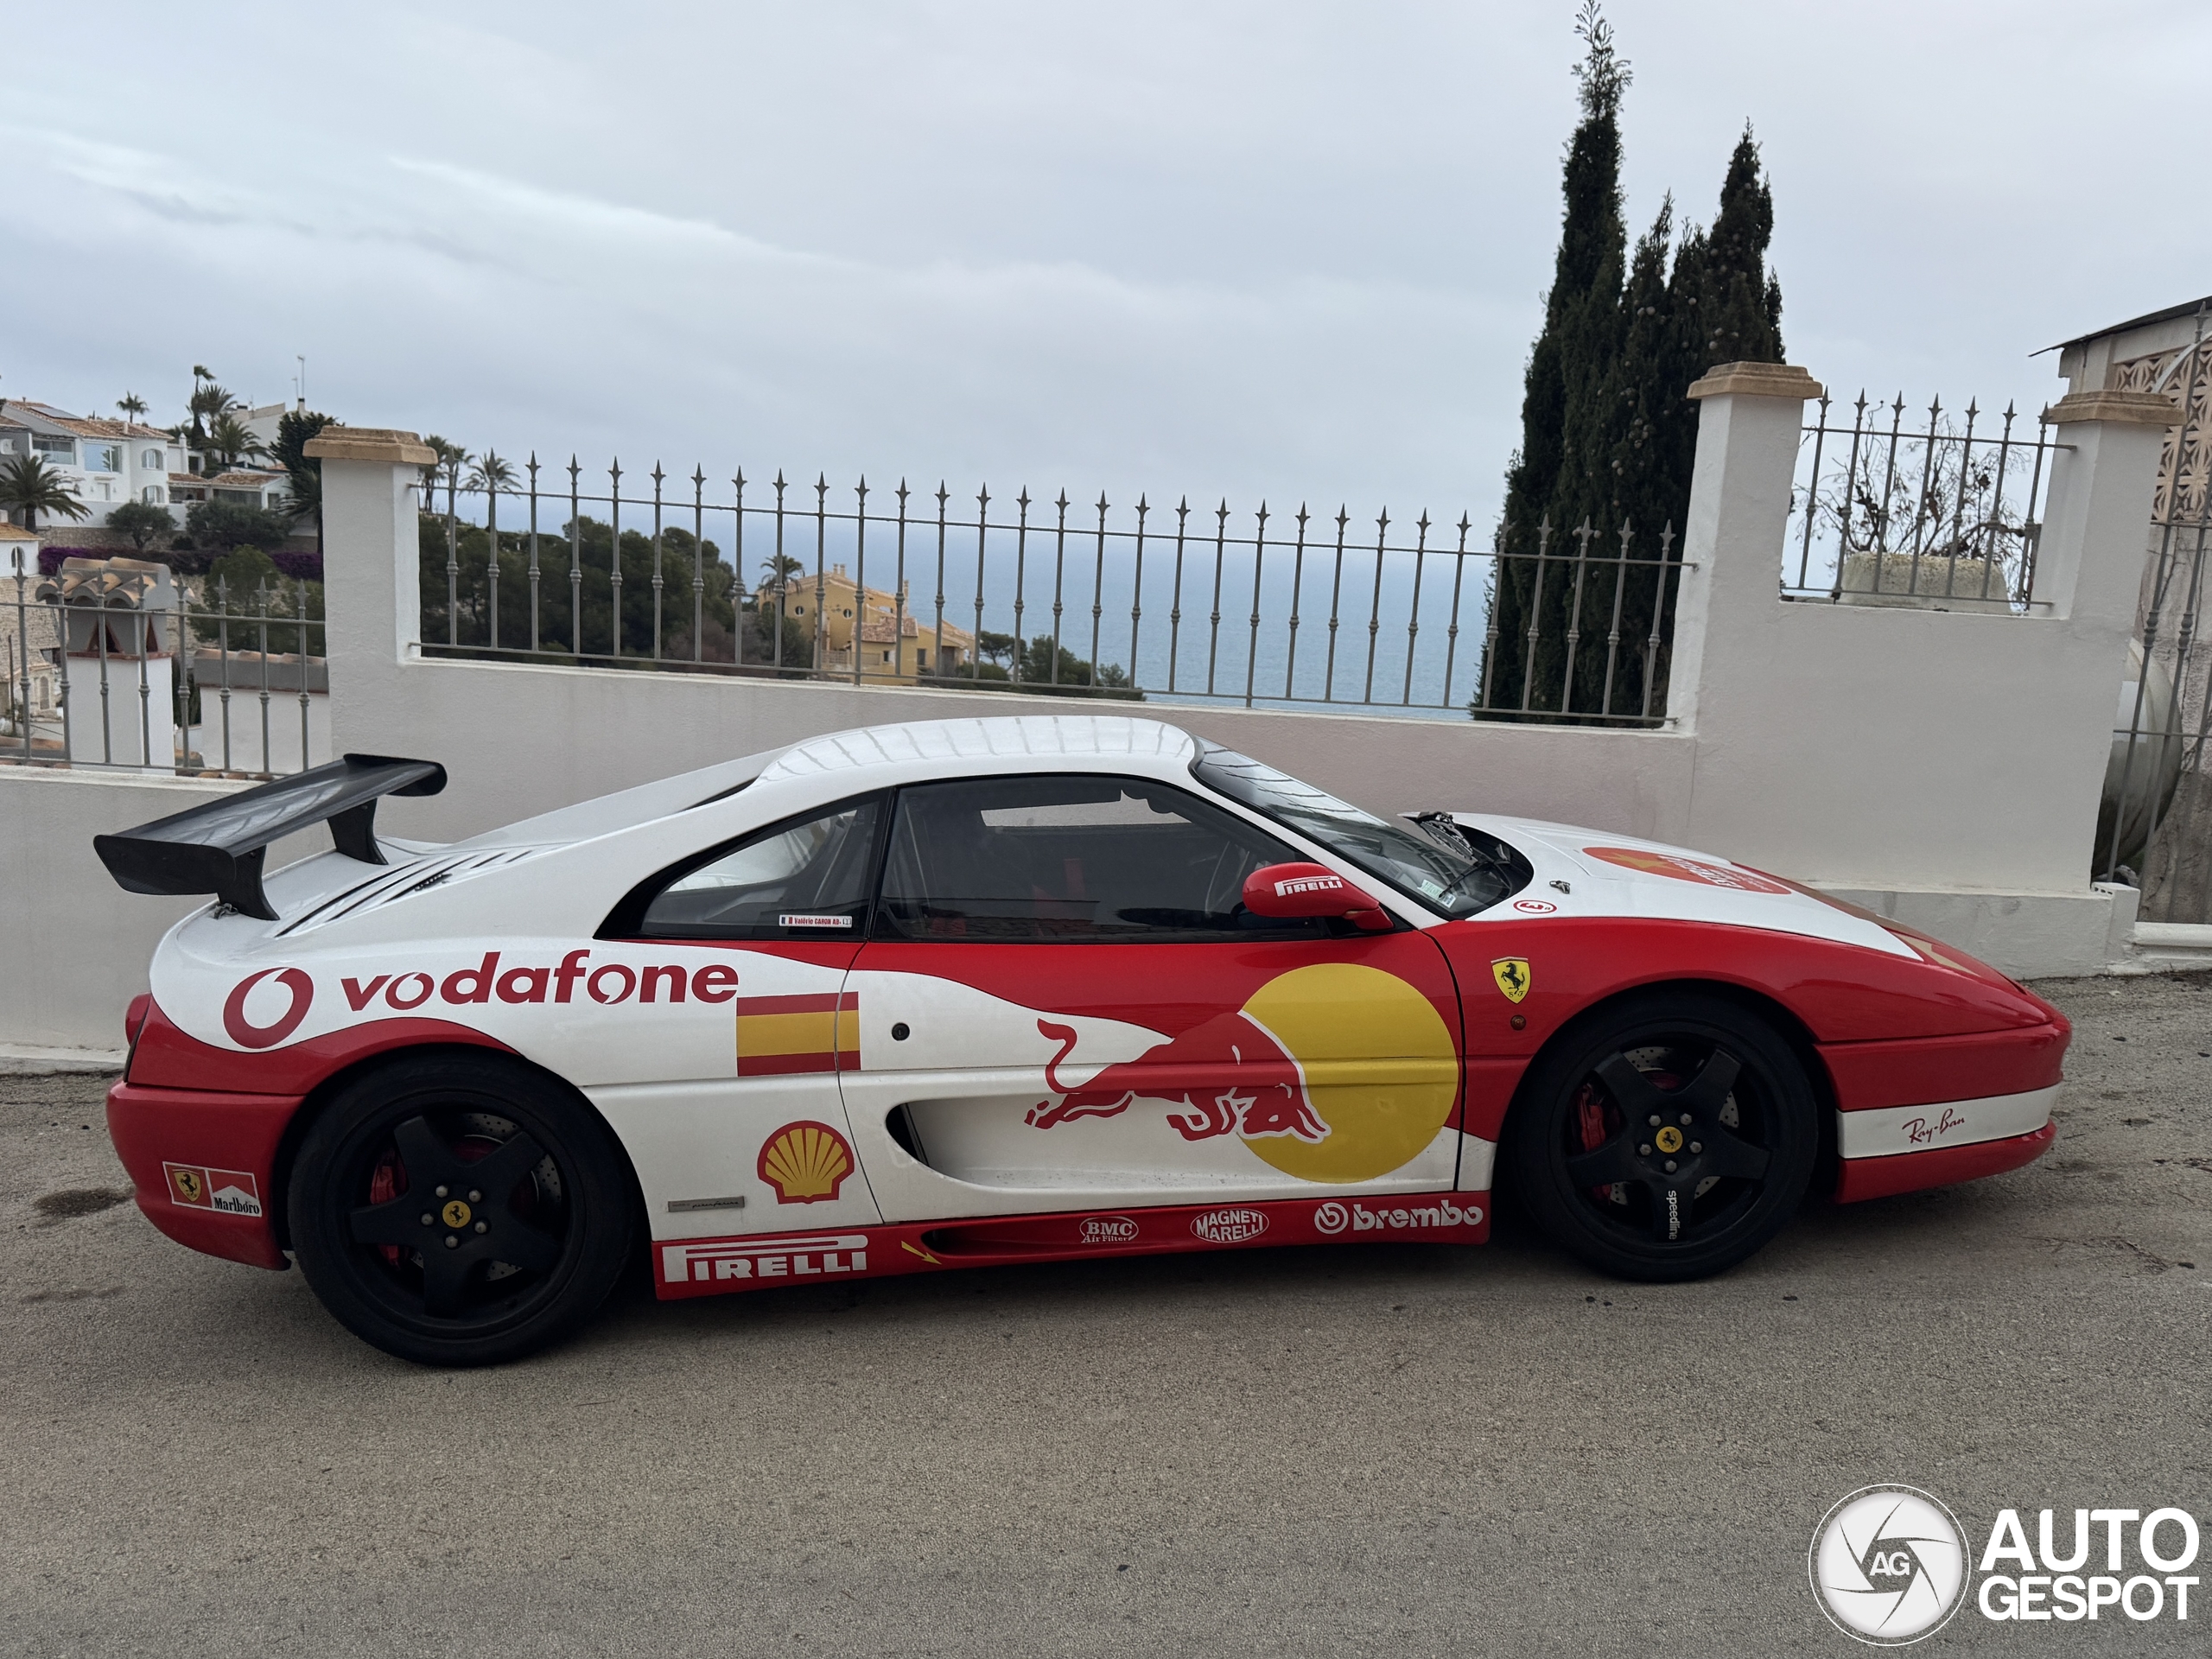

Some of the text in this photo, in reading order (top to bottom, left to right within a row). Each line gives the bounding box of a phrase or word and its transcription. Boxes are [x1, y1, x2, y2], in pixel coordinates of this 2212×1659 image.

[1274, 875, 1343, 897] PIRELLI
[340, 949, 738, 1012] vodafone
[1902, 1108, 1965, 1144] Ray-Ban
[213, 1197, 260, 1215] Marlboro
[1353, 1199, 1484, 1231] brembo
[1666, 1190, 1681, 1240] speedline
[1086, 1222, 1133, 1236] BMC
[1196, 1210, 1263, 1232] MAGNETI
[1081, 1235, 1100, 1243] Air
[662, 1235, 868, 1283] PIRELLI
